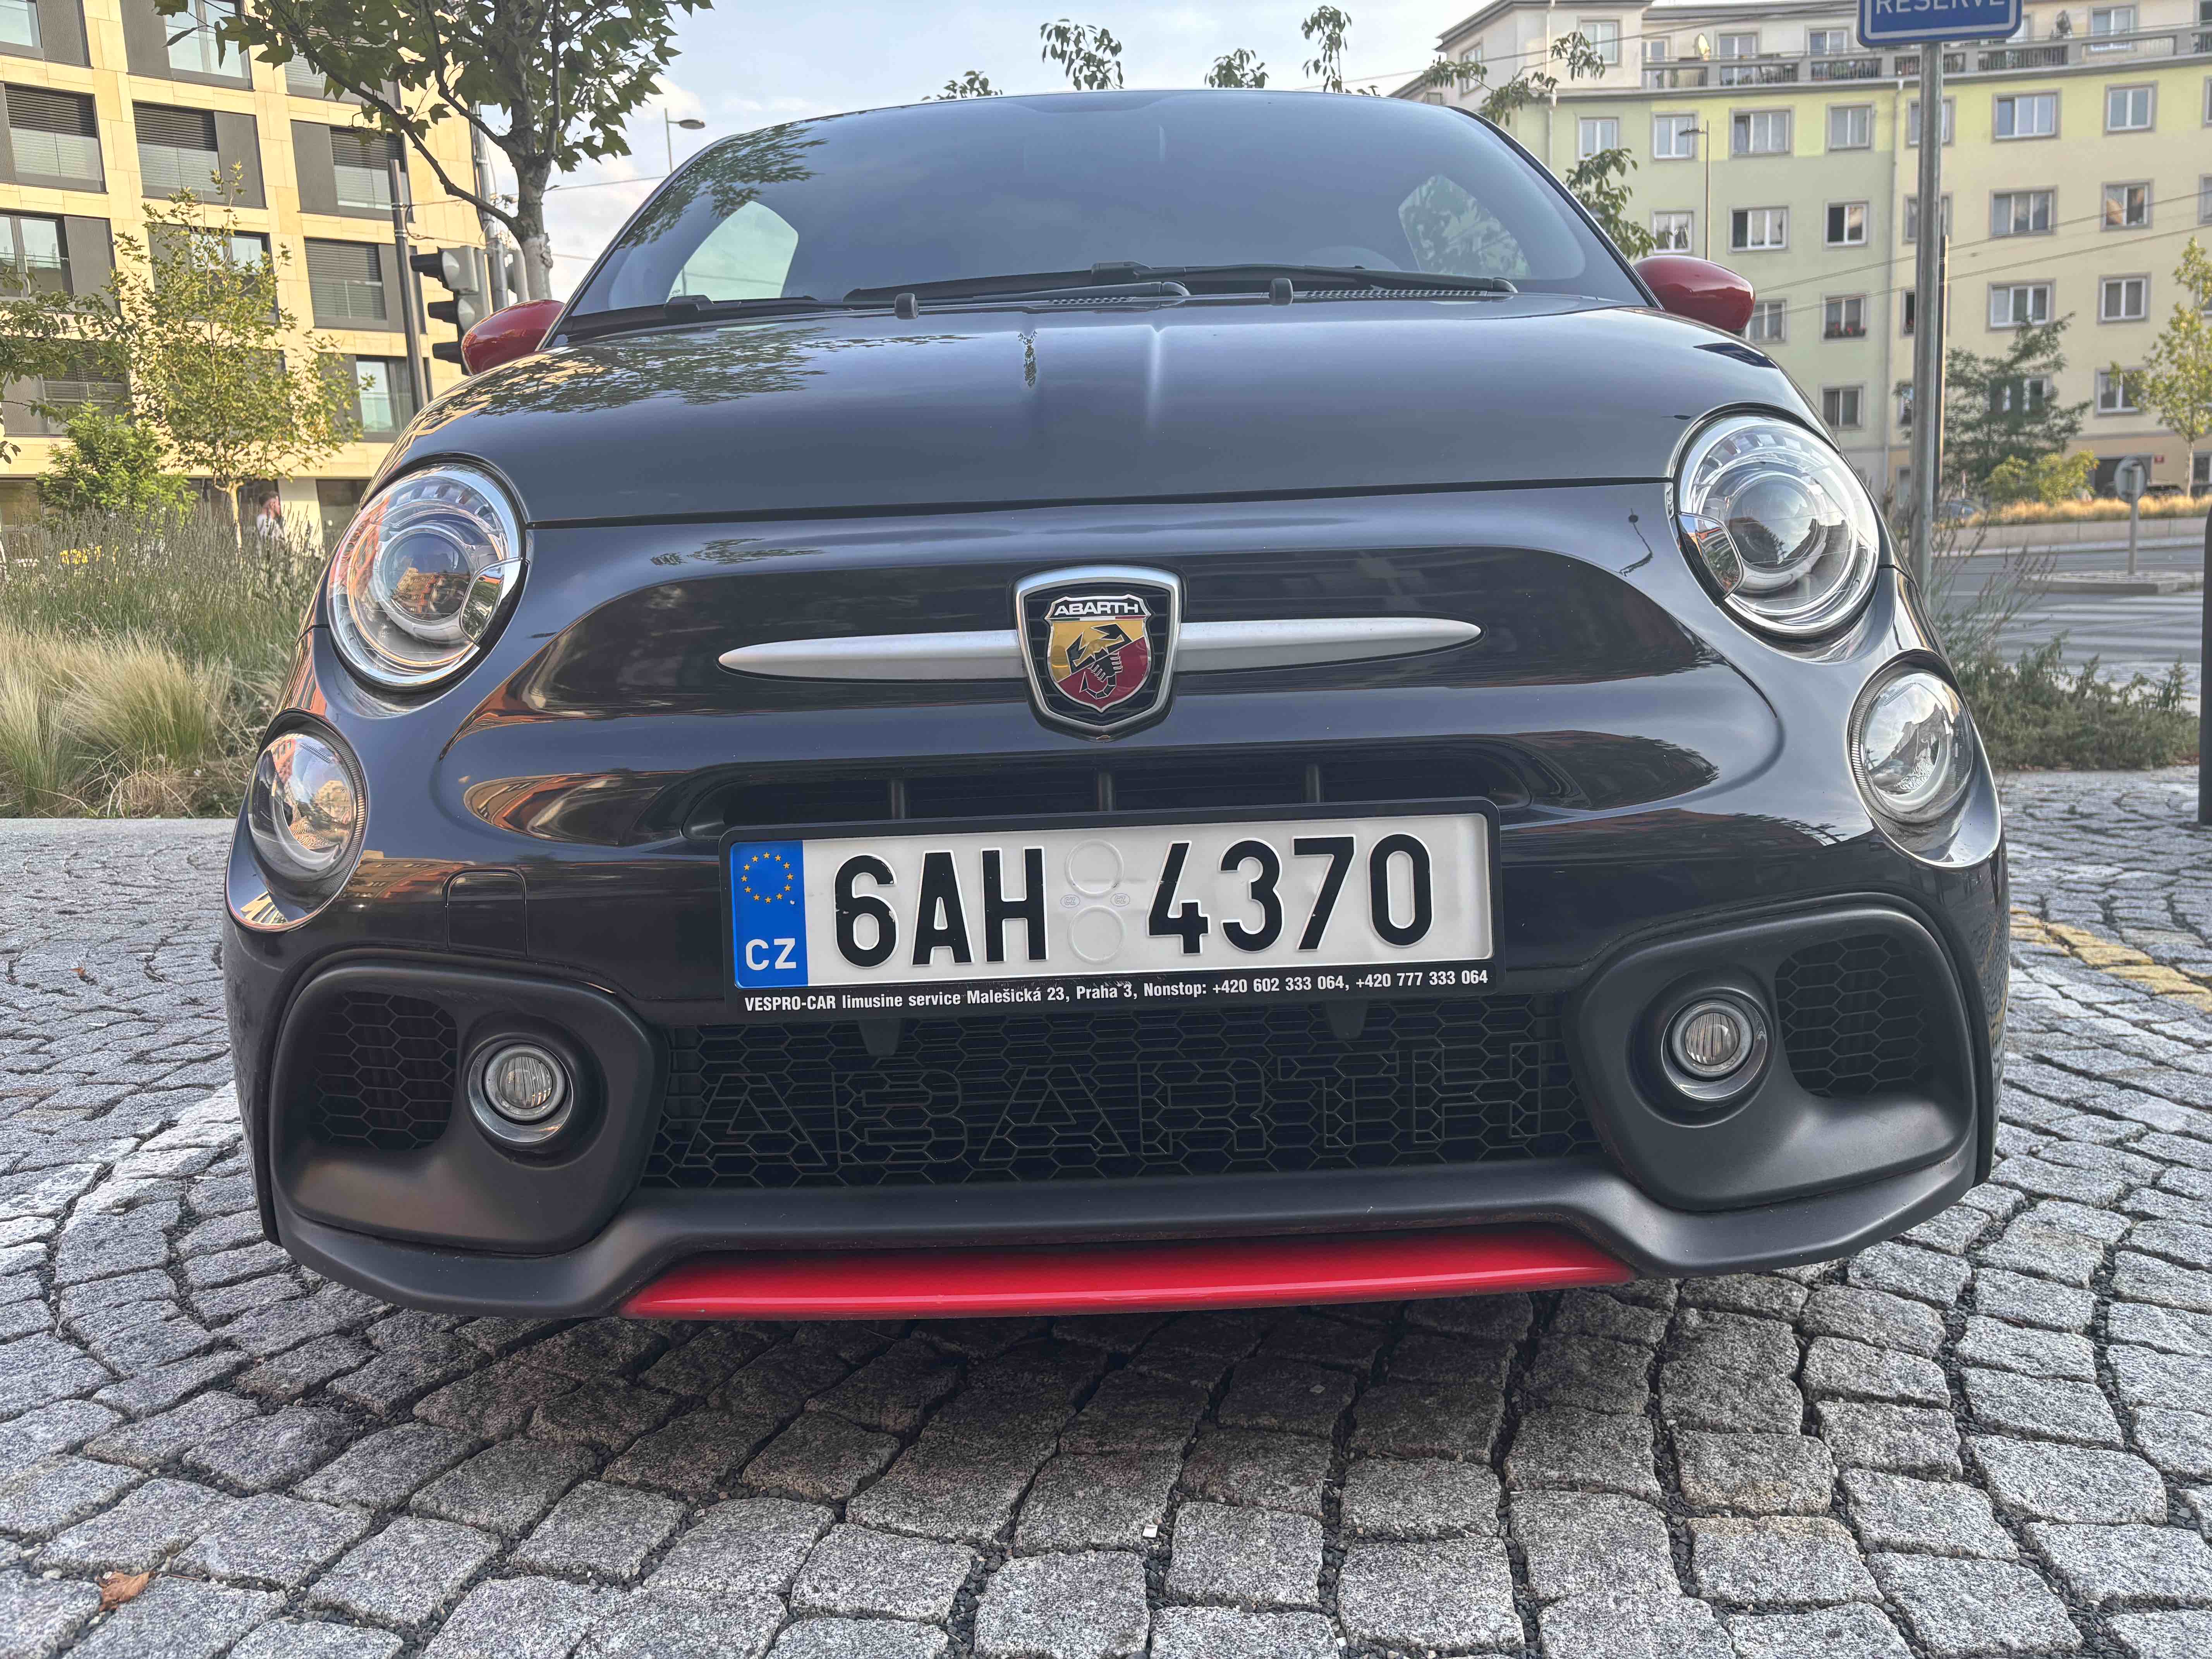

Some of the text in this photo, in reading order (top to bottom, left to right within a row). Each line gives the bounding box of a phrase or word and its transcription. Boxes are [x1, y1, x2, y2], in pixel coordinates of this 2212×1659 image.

[1054, 601, 1139, 616] ABARTH
[834, 833, 1433, 968] 6AH 4370
[745, 938, 797, 970] CZ
[745, 970, 1489, 1011] VESPRO-CAR limusine service Malešická 23, Praha 3, Nonstop: +420 602 333 064, +420 777 333 064
[680, 1041, 1542, 1168] ABARTH
